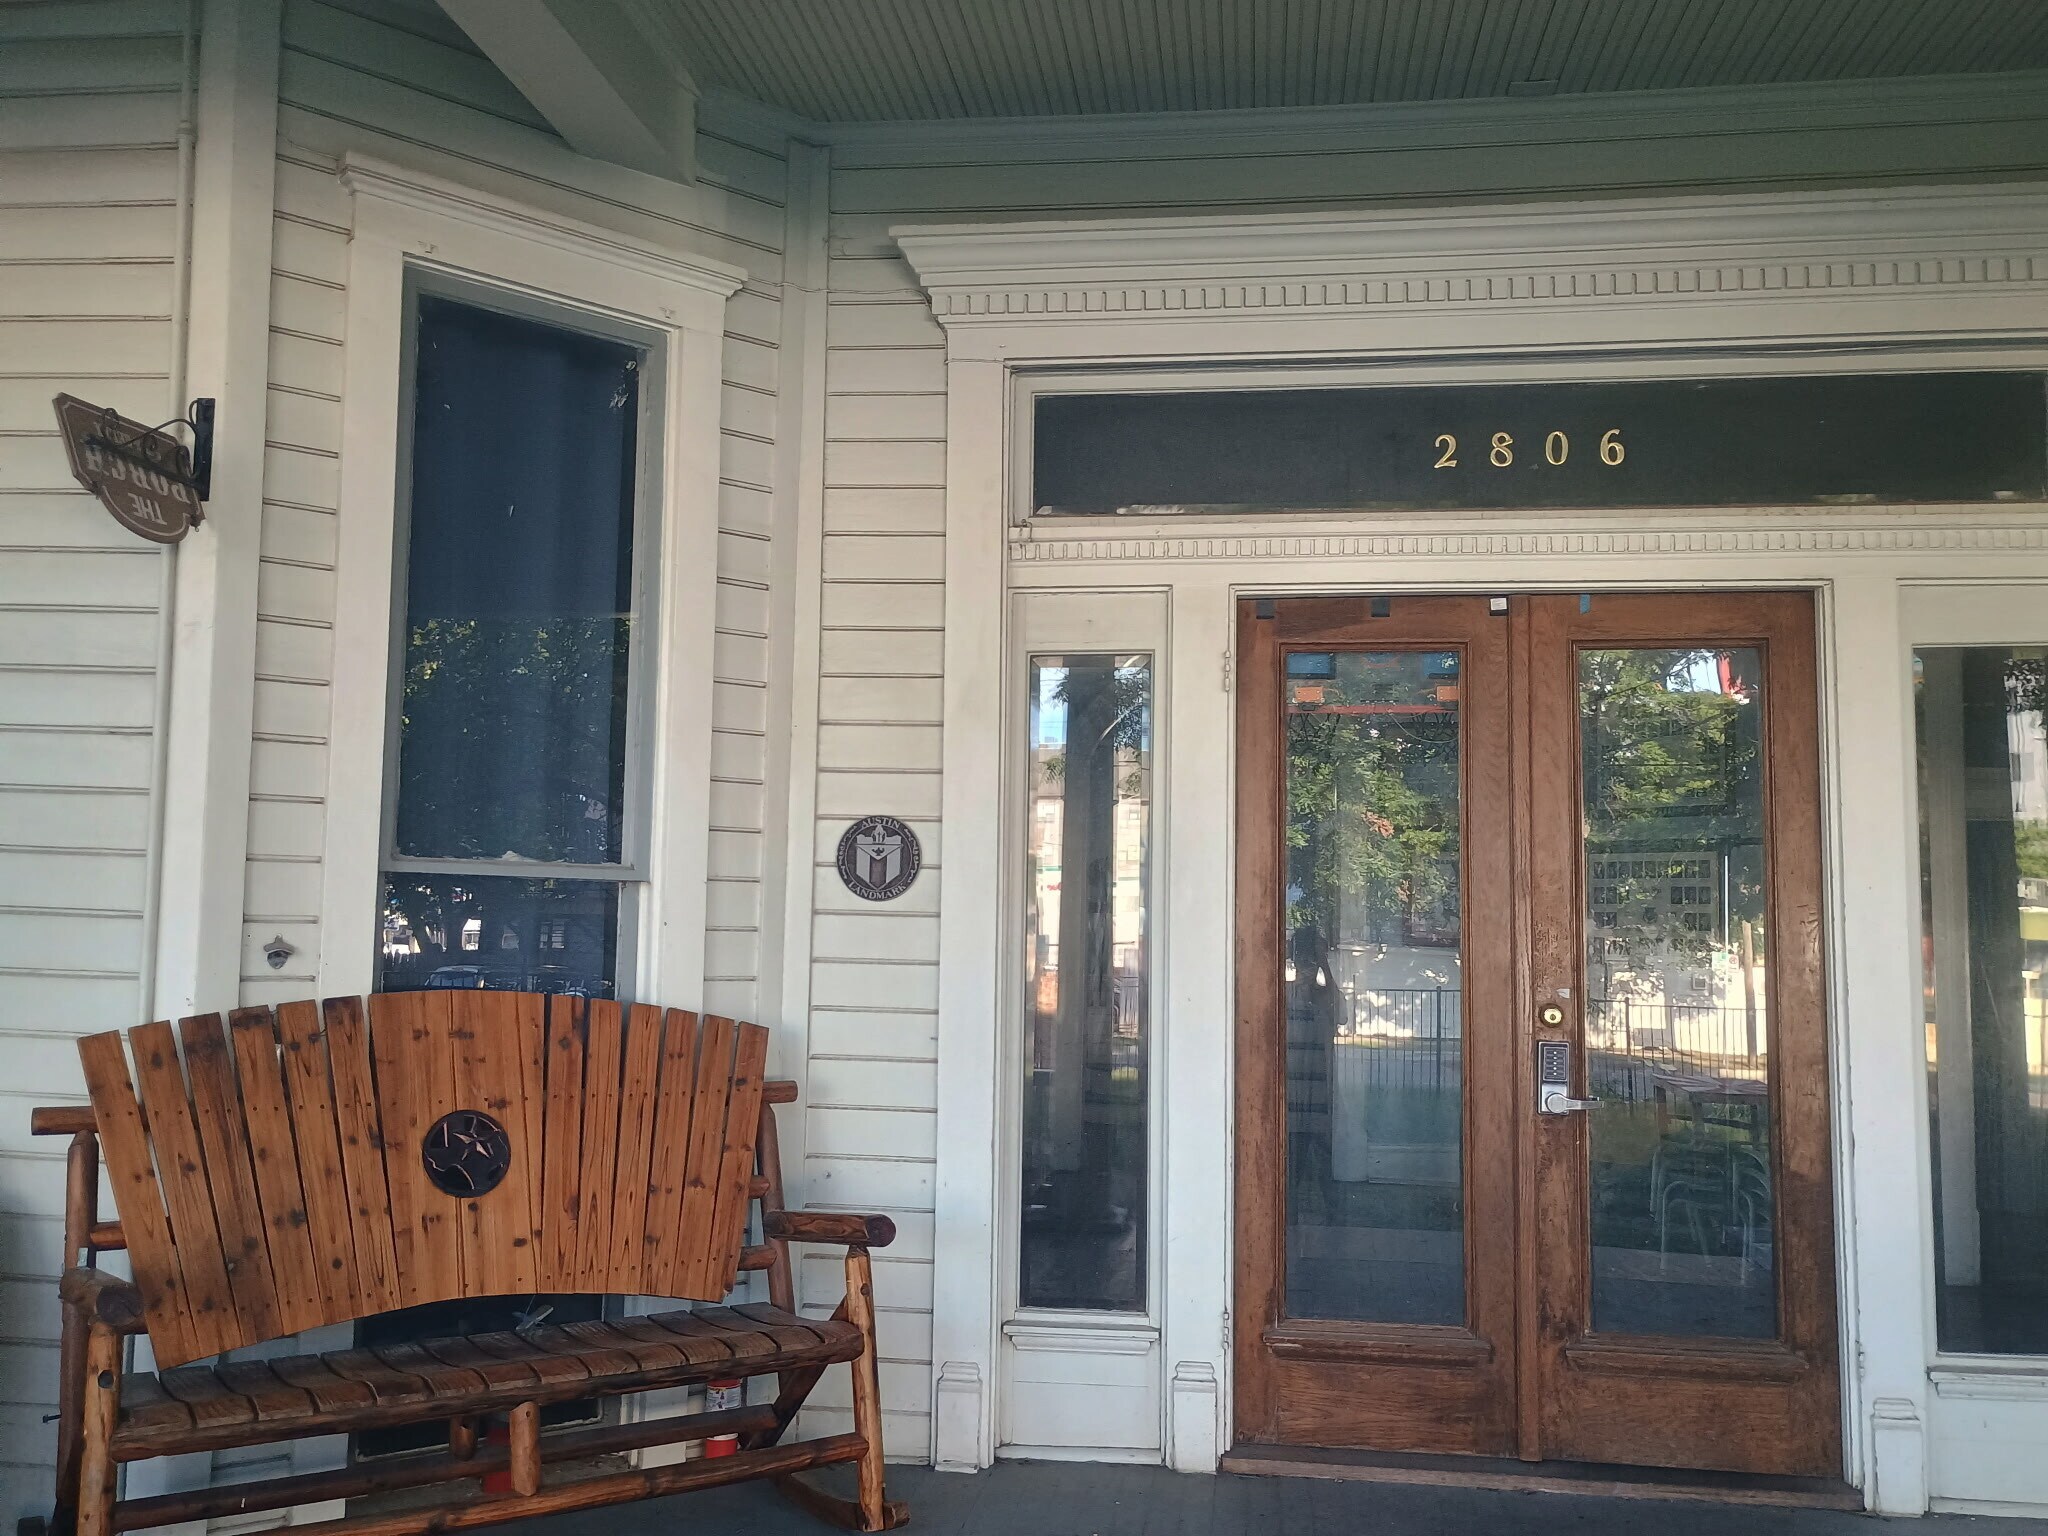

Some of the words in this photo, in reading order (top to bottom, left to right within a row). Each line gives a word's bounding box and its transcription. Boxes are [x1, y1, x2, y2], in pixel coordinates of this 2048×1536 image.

[1433, 428, 1626, 469] 2806
[127, 492, 168, 526] THE
[861, 816, 901, 829] AUSTIN
[848, 881, 907, 900] LANDMARK
